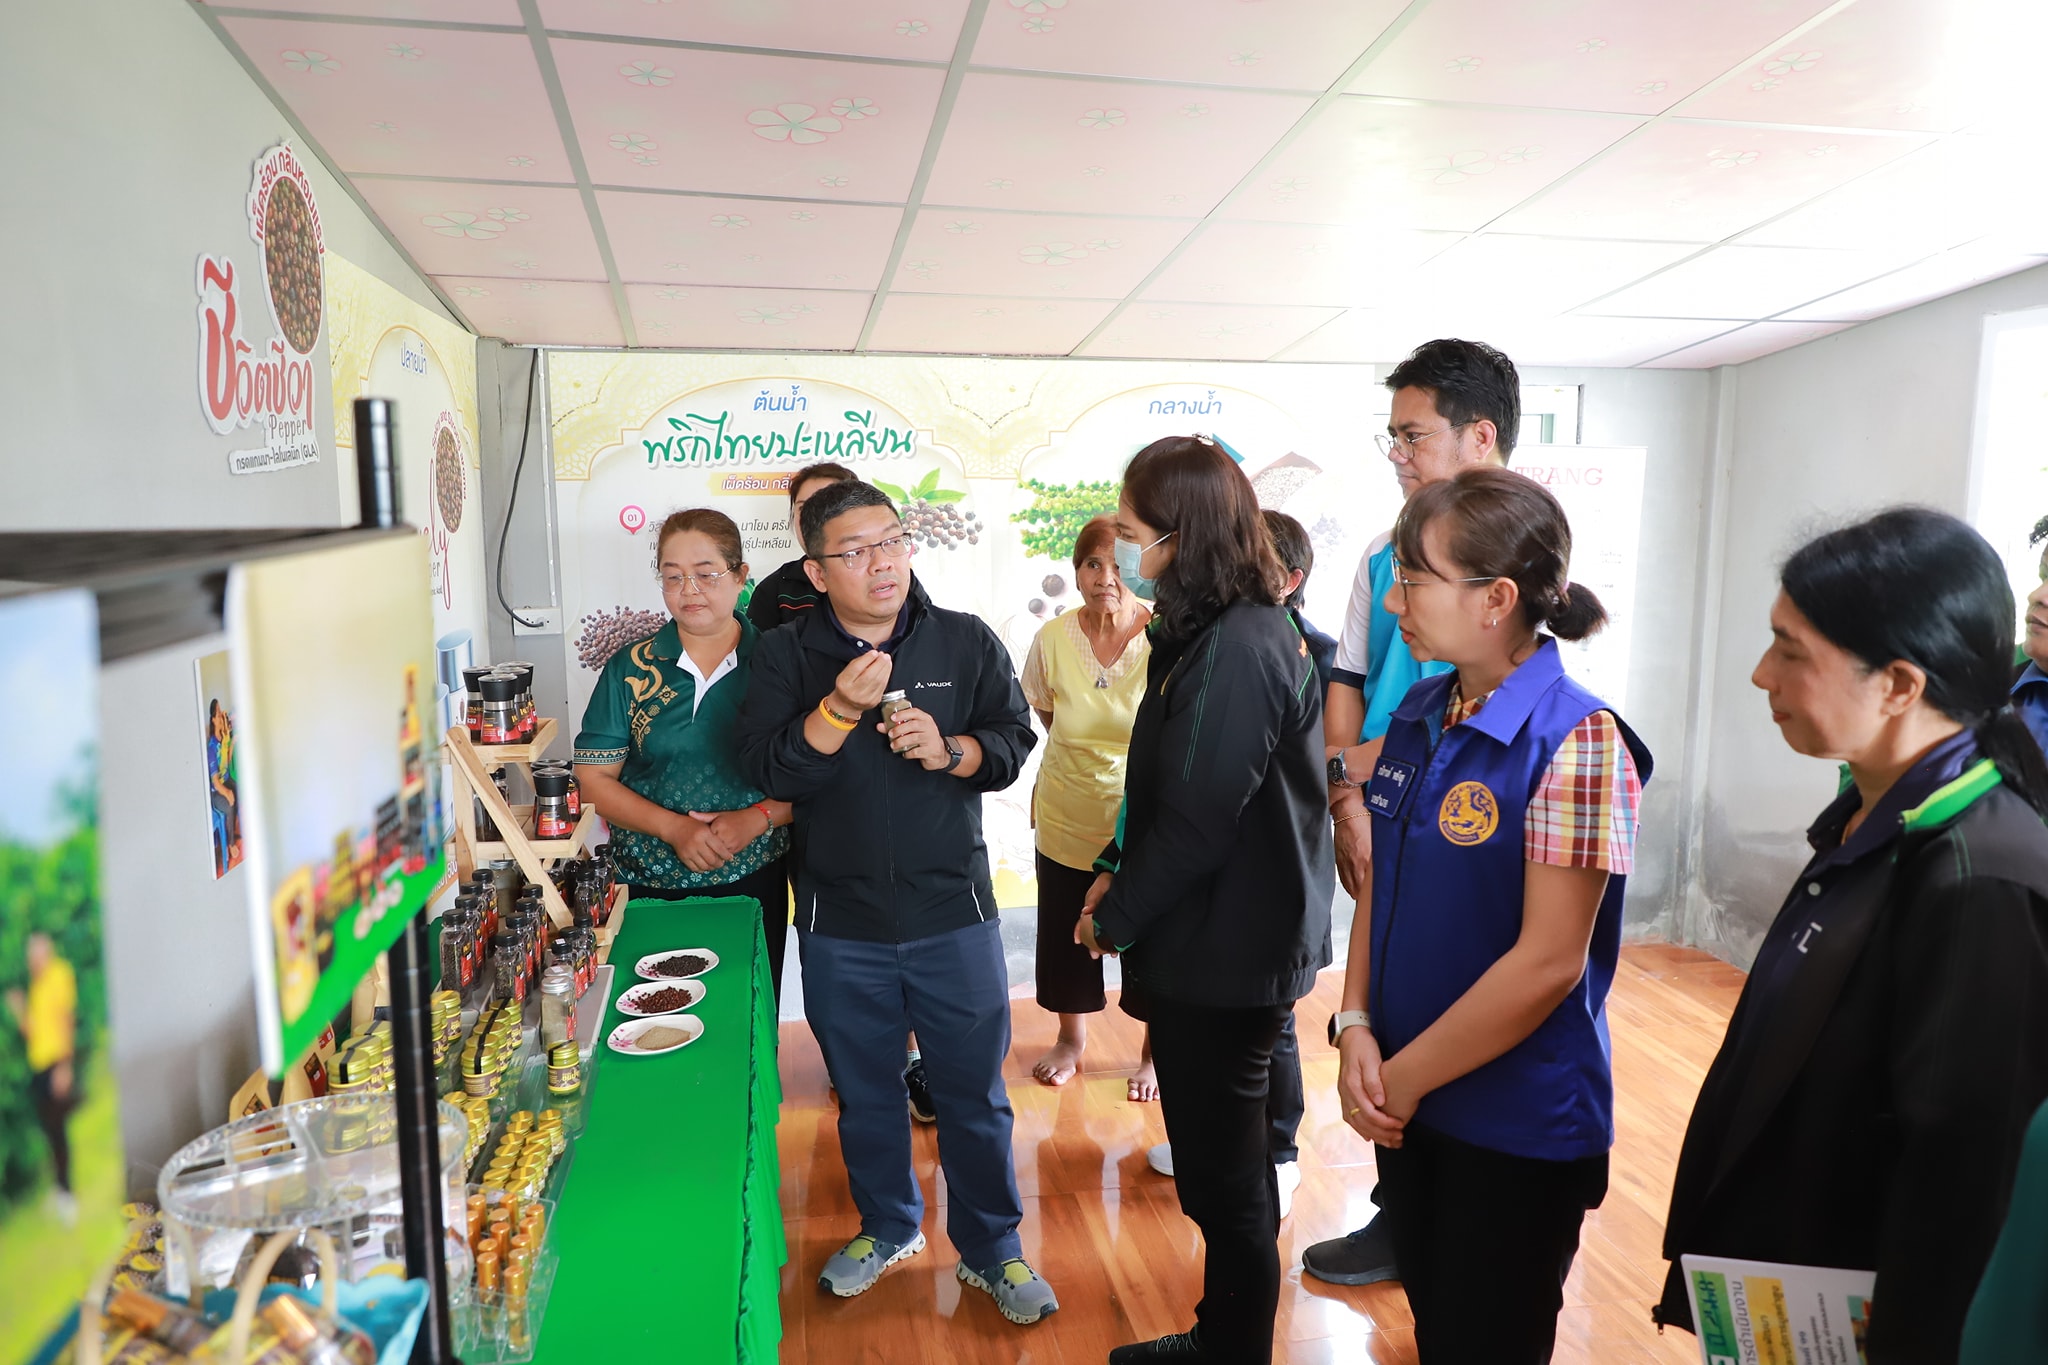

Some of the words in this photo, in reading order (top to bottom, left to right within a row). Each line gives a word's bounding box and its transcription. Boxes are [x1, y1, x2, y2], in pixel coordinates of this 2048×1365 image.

[401, 341, 427, 375] ปลายน้ำ
[753, 385, 807, 412] ต้นน้ำ
[1149, 390, 1222, 415] กลางน้ำ
[268, 414, 307, 442] Pepper
[642, 410, 913, 464] พริกไทยปะเหลียน
[300, 442, 319, 461] (GLA)
[722, 473, 769, 490] เผ็ดร้อน
[772, 473, 792, 490] กลิ่
[1515, 466, 1603, 486] TRANG
[627, 513, 638, 522] 01
[741, 519, 769, 531] นาโยง
[1731, 1280, 1758, 1365] ารดำเนินงาน
